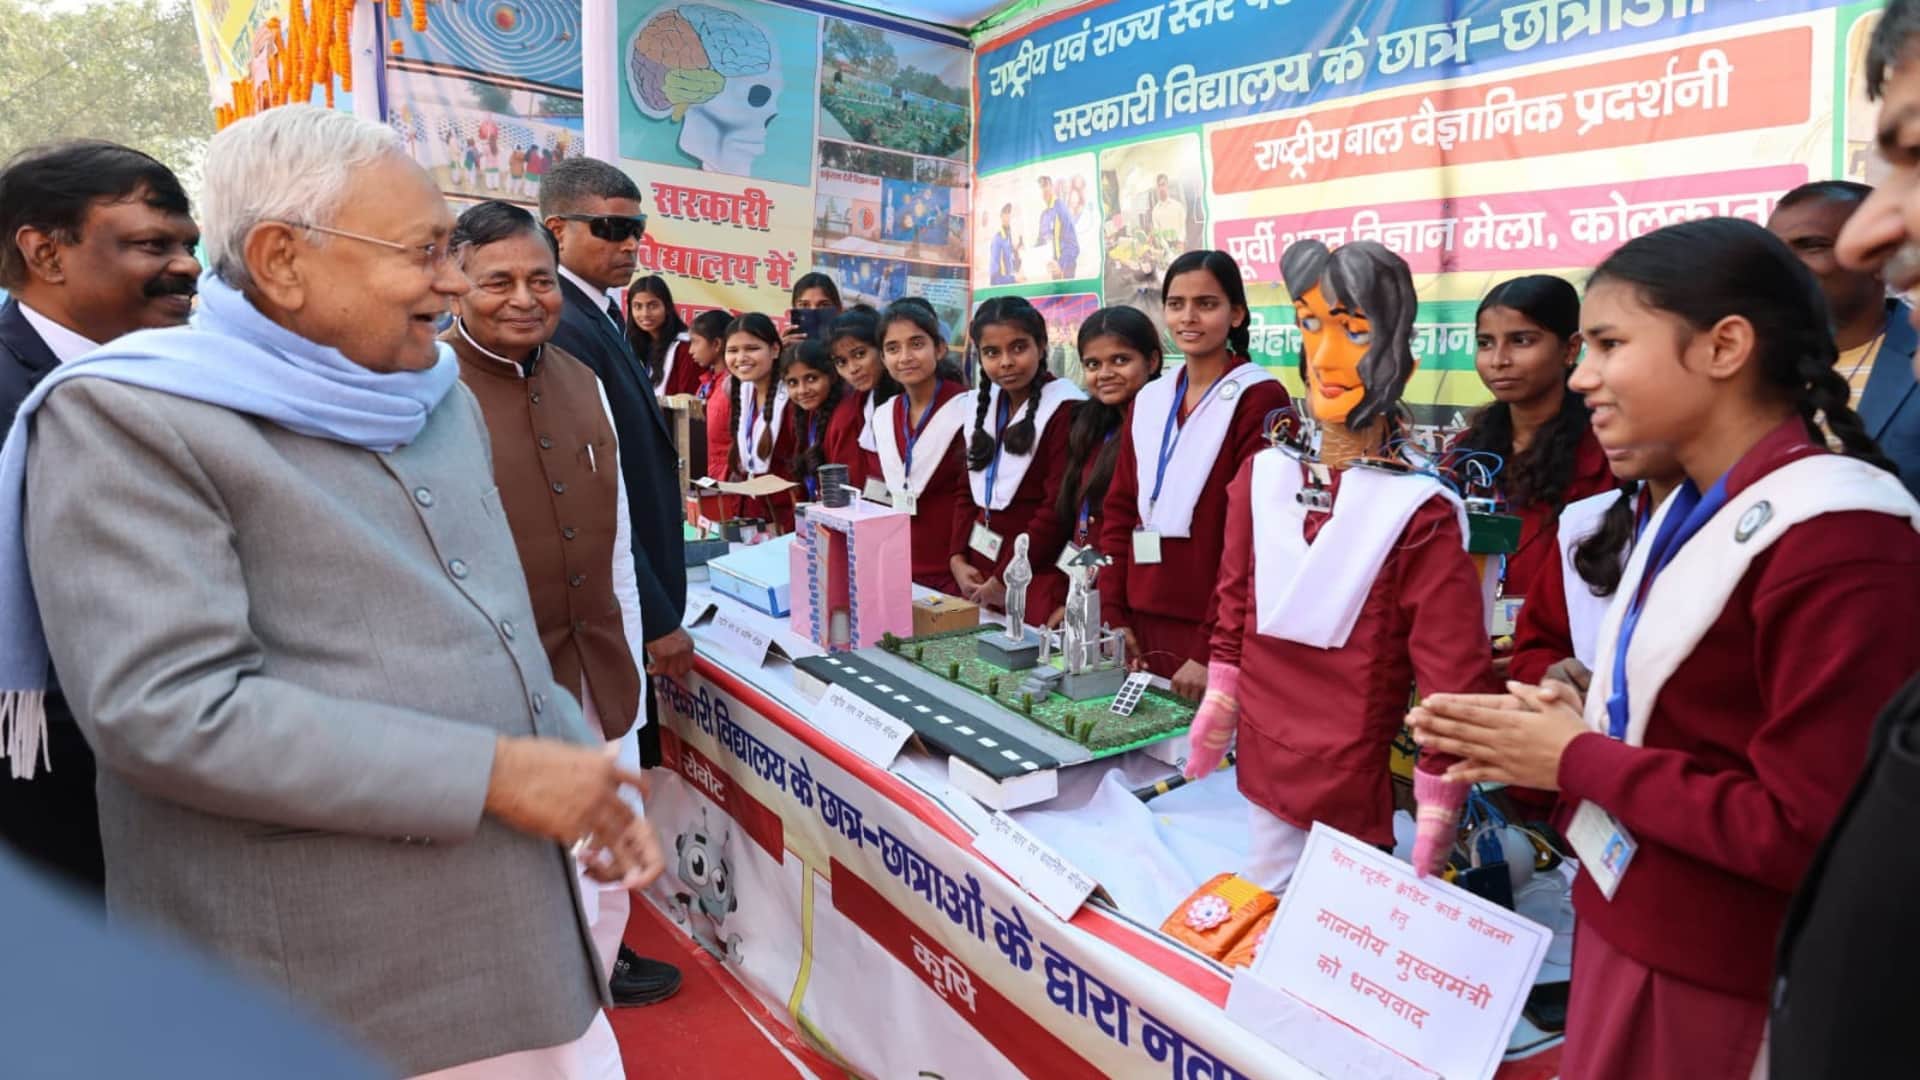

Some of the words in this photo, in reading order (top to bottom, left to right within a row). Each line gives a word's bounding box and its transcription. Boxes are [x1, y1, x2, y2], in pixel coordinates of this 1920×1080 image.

[989, 39, 1051, 98] राष्ट्रीय
[1053, 17, 1091, 71] एवं
[1092, 4, 1165, 57] राज्य
[1053, 73, 1158, 142] सरकारी
[1164, 52, 1312, 119] विद्यालय
[1319, 26, 1368, 85] के
[1254, 119, 1342, 180] राष्ट्रीय
[1344, 115, 1408, 156] बाल
[1409, 86, 1566, 151] वैज्ञानिक
[1574, 48, 1734, 136] प्रदर्शनी
[651, 182, 773, 231] सरकारी
[1227, 221, 1276, 280] पूर्वी
[1463, 202, 1558, 251] मेला,
[764, 250, 796, 290] में
[681, 752, 725, 800] रोबोट
[715, 697, 786, 792] विद्यालय
[788, 757, 813, 808] के
[990, 905, 1033, 972] के
[1040, 941, 1131, 1047] द्वारा
[1316, 908, 1390, 957] माननीय
[1396, 950, 1493, 1010] मुख्यमंत्री
[1468, 914, 1516, 945] योजना
[910, 935, 978, 1014] कृषि
[1316, 953, 1343, 979] को
[1350, 971, 1431, 1029] धन्यवाद
